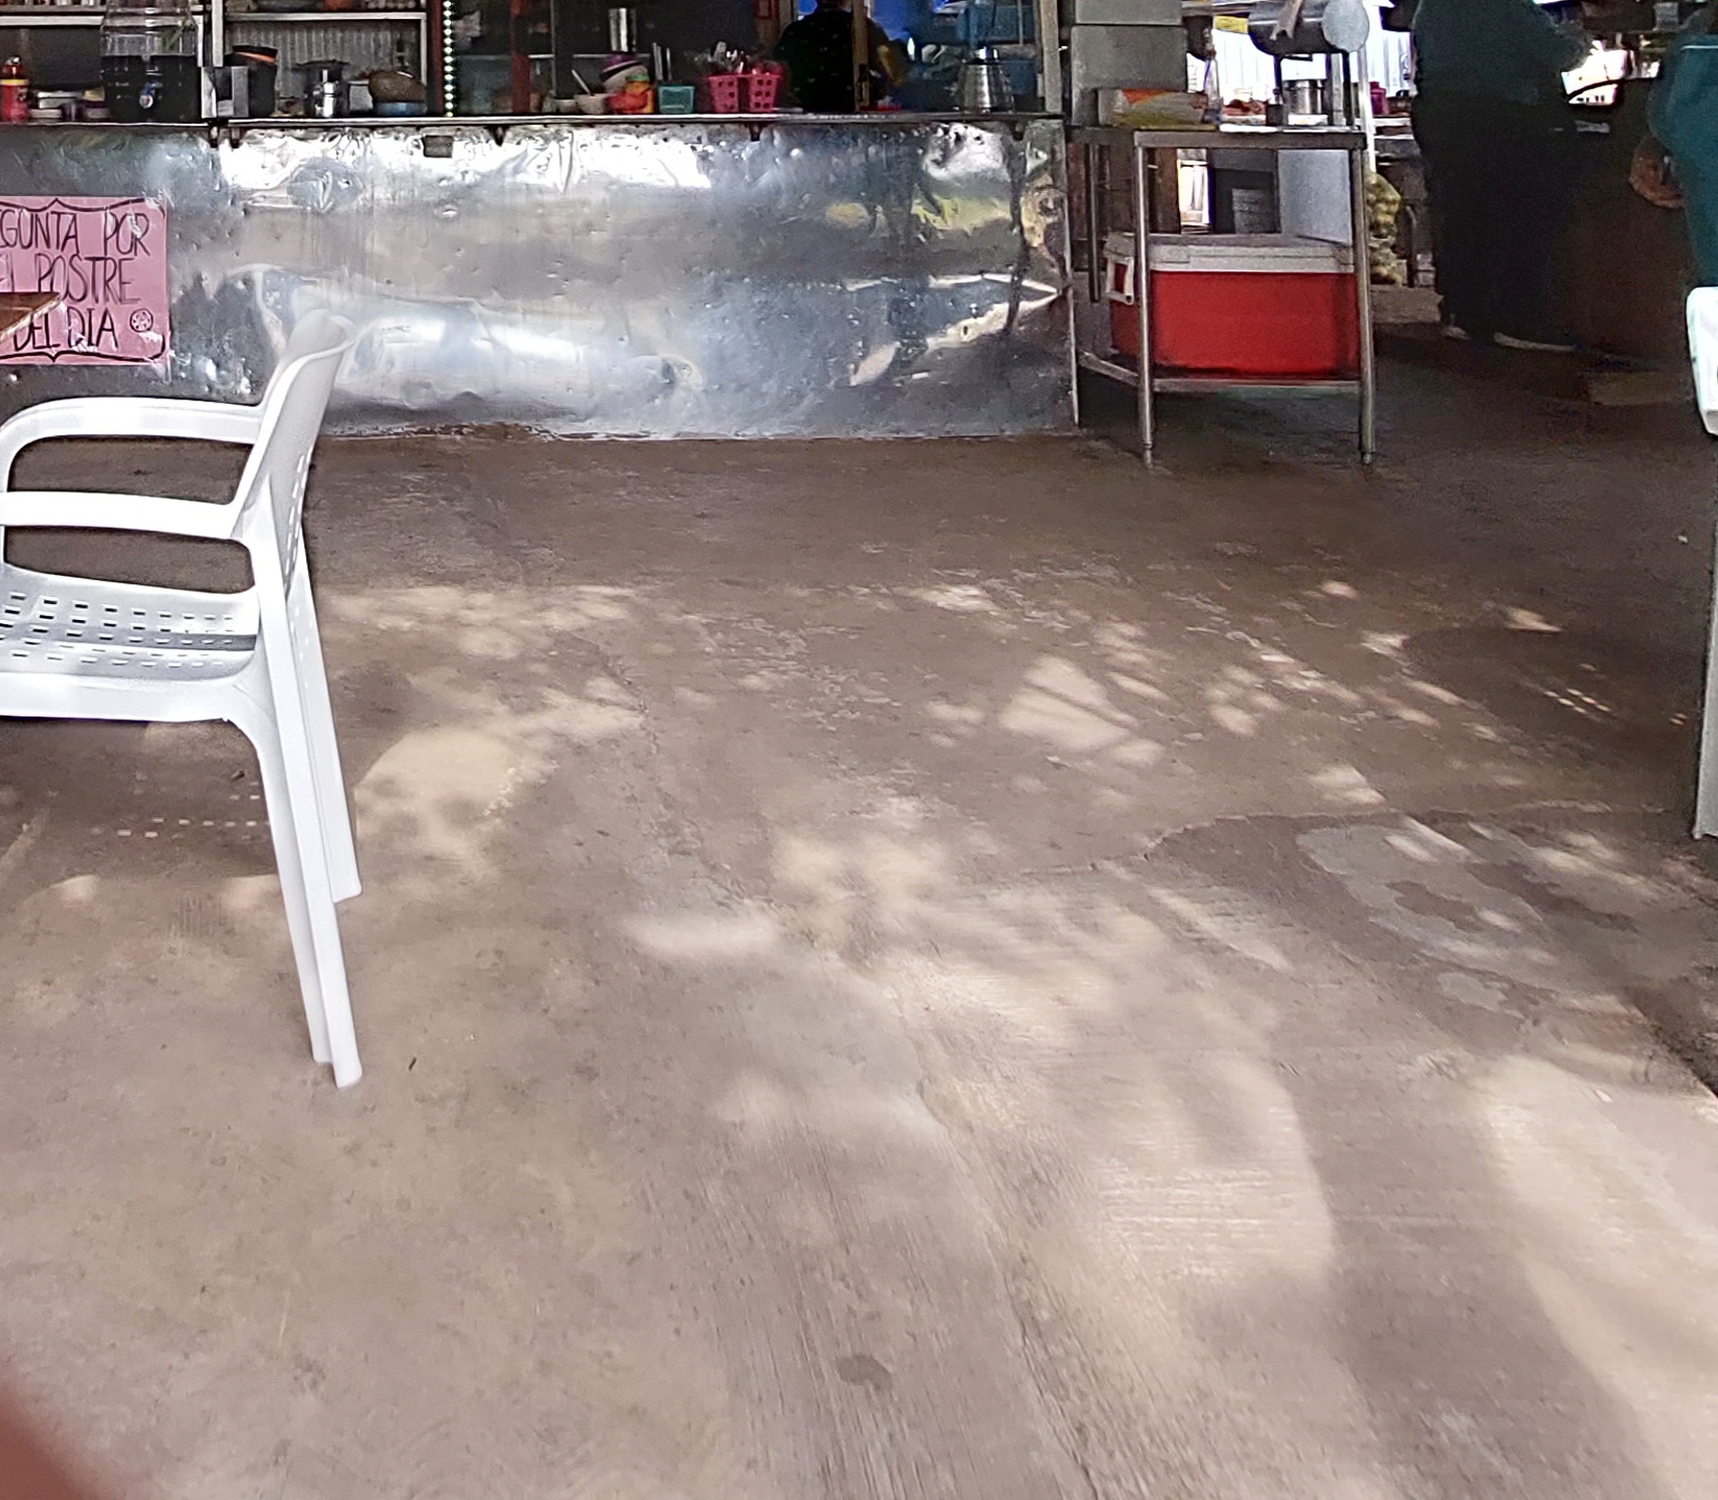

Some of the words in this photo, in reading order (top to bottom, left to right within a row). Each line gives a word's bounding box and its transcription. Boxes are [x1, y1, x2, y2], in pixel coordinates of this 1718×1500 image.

[104, 211, 151, 257] POR
[35, 253, 141, 305] POSTRE
[67, 306, 119, 350] DIA
